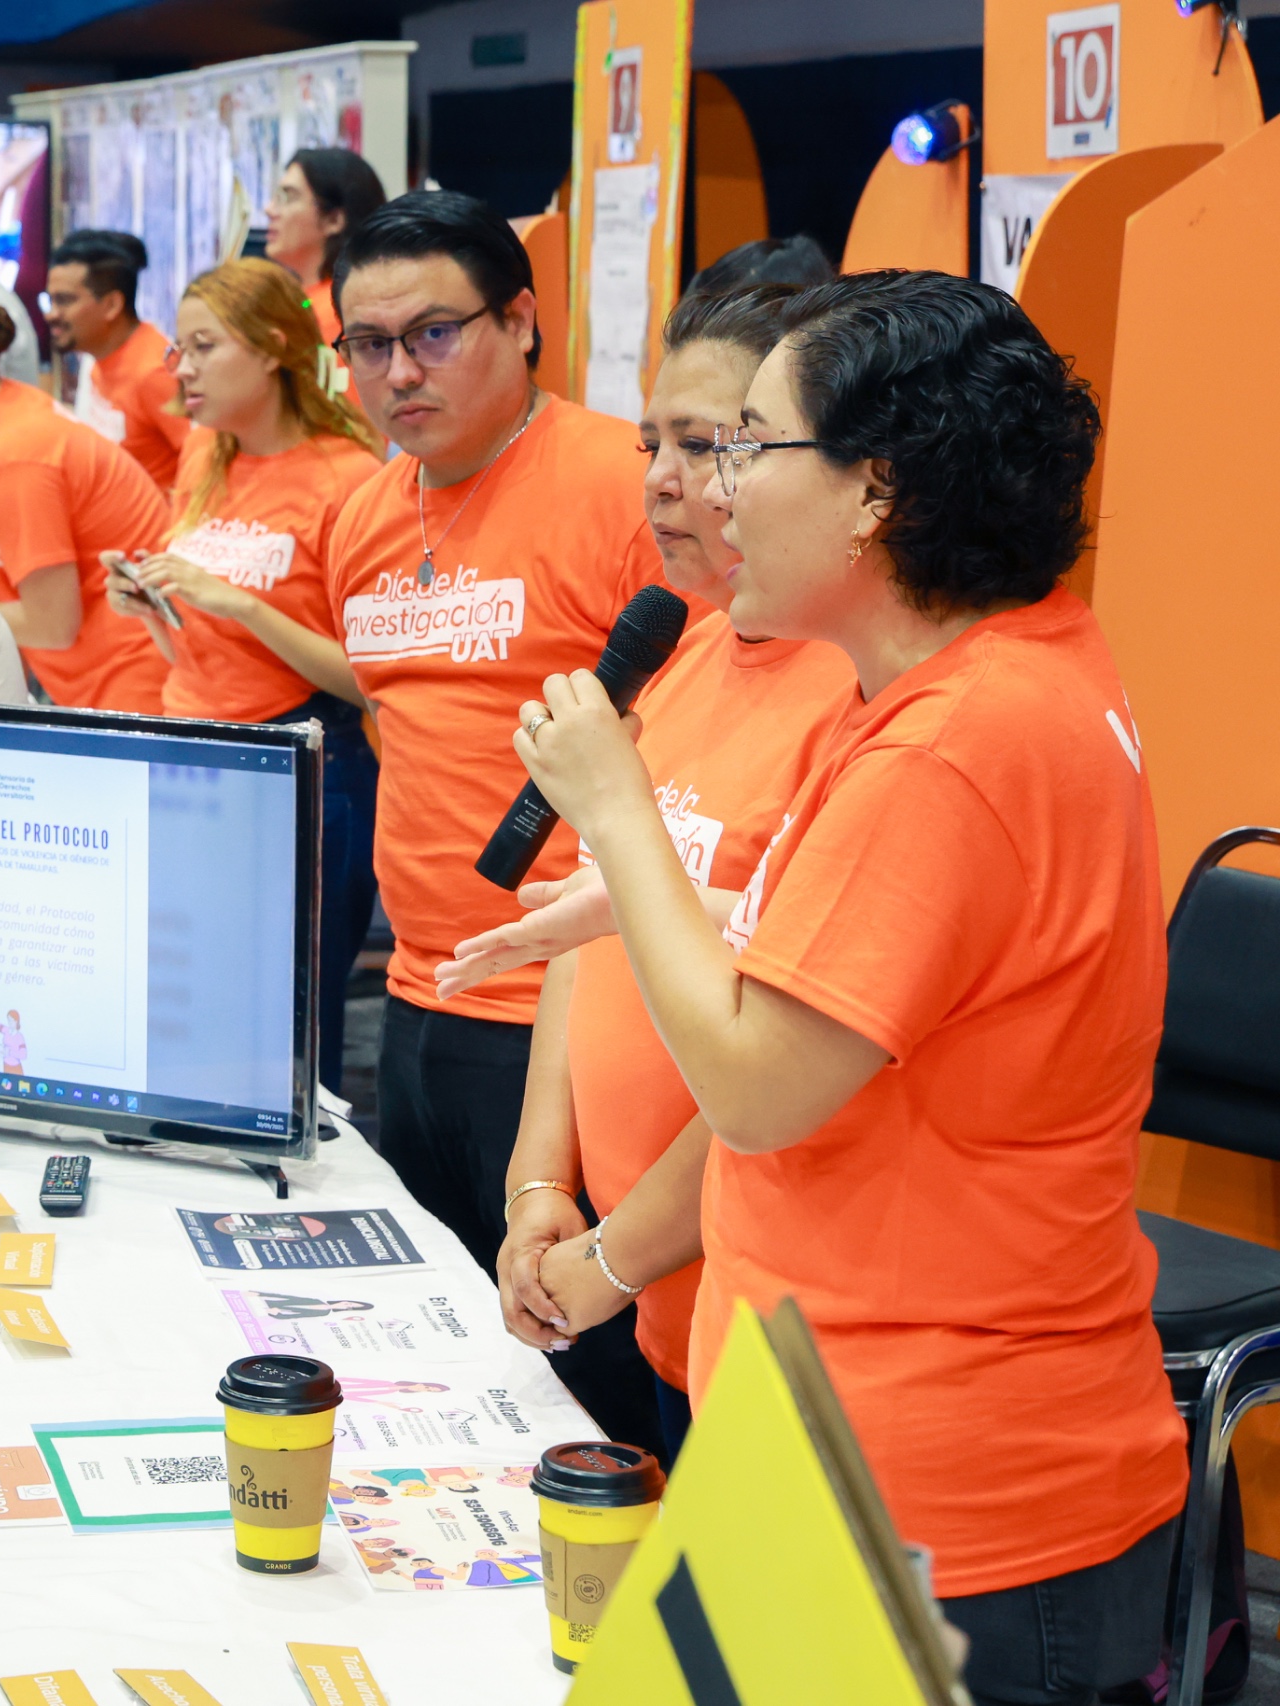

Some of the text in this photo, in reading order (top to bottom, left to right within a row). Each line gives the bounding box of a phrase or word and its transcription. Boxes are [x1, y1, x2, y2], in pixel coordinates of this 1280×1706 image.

[1060, 31, 1107, 120] 10
[228, 567, 277, 592] UAT
[373, 568, 415, 603] Día
[452, 564, 479, 595] la
[451, 628, 514, 663] UAT
[24, 822, 109, 850] PROTOCOLO
[4, 861, 13, 869] DE
[10, 848, 19, 857] DE
[20, 849, 57, 862] VIOLENCIA
[59, 854, 68, 862] DE
[69, 854, 98, 866] GÉNERO
[100, 858, 110, 866] DE
[26, 904, 36, 916] el
[40, 905, 95, 922] Protocolo
[63, 926, 95, 940] cómo
[8, 937, 67, 954] garantizar
[73, 945, 95, 957] una
[11, 955, 19, 965] a
[25, 955, 41, 968] las
[47, 958, 95, 975] víctimas
[350, 1217, 378, 1240] DENUNCIA
[429, 1297, 468, 1338] En Tampico
[487, 1389, 531, 1434] En Altamira
[228, 1483, 288, 1510] ndatti
[463, 1499, 508, 1546] 834 3008616
[567, 1509, 603, 1517] andatti.com
[341, 1654, 360, 1680] Trata
